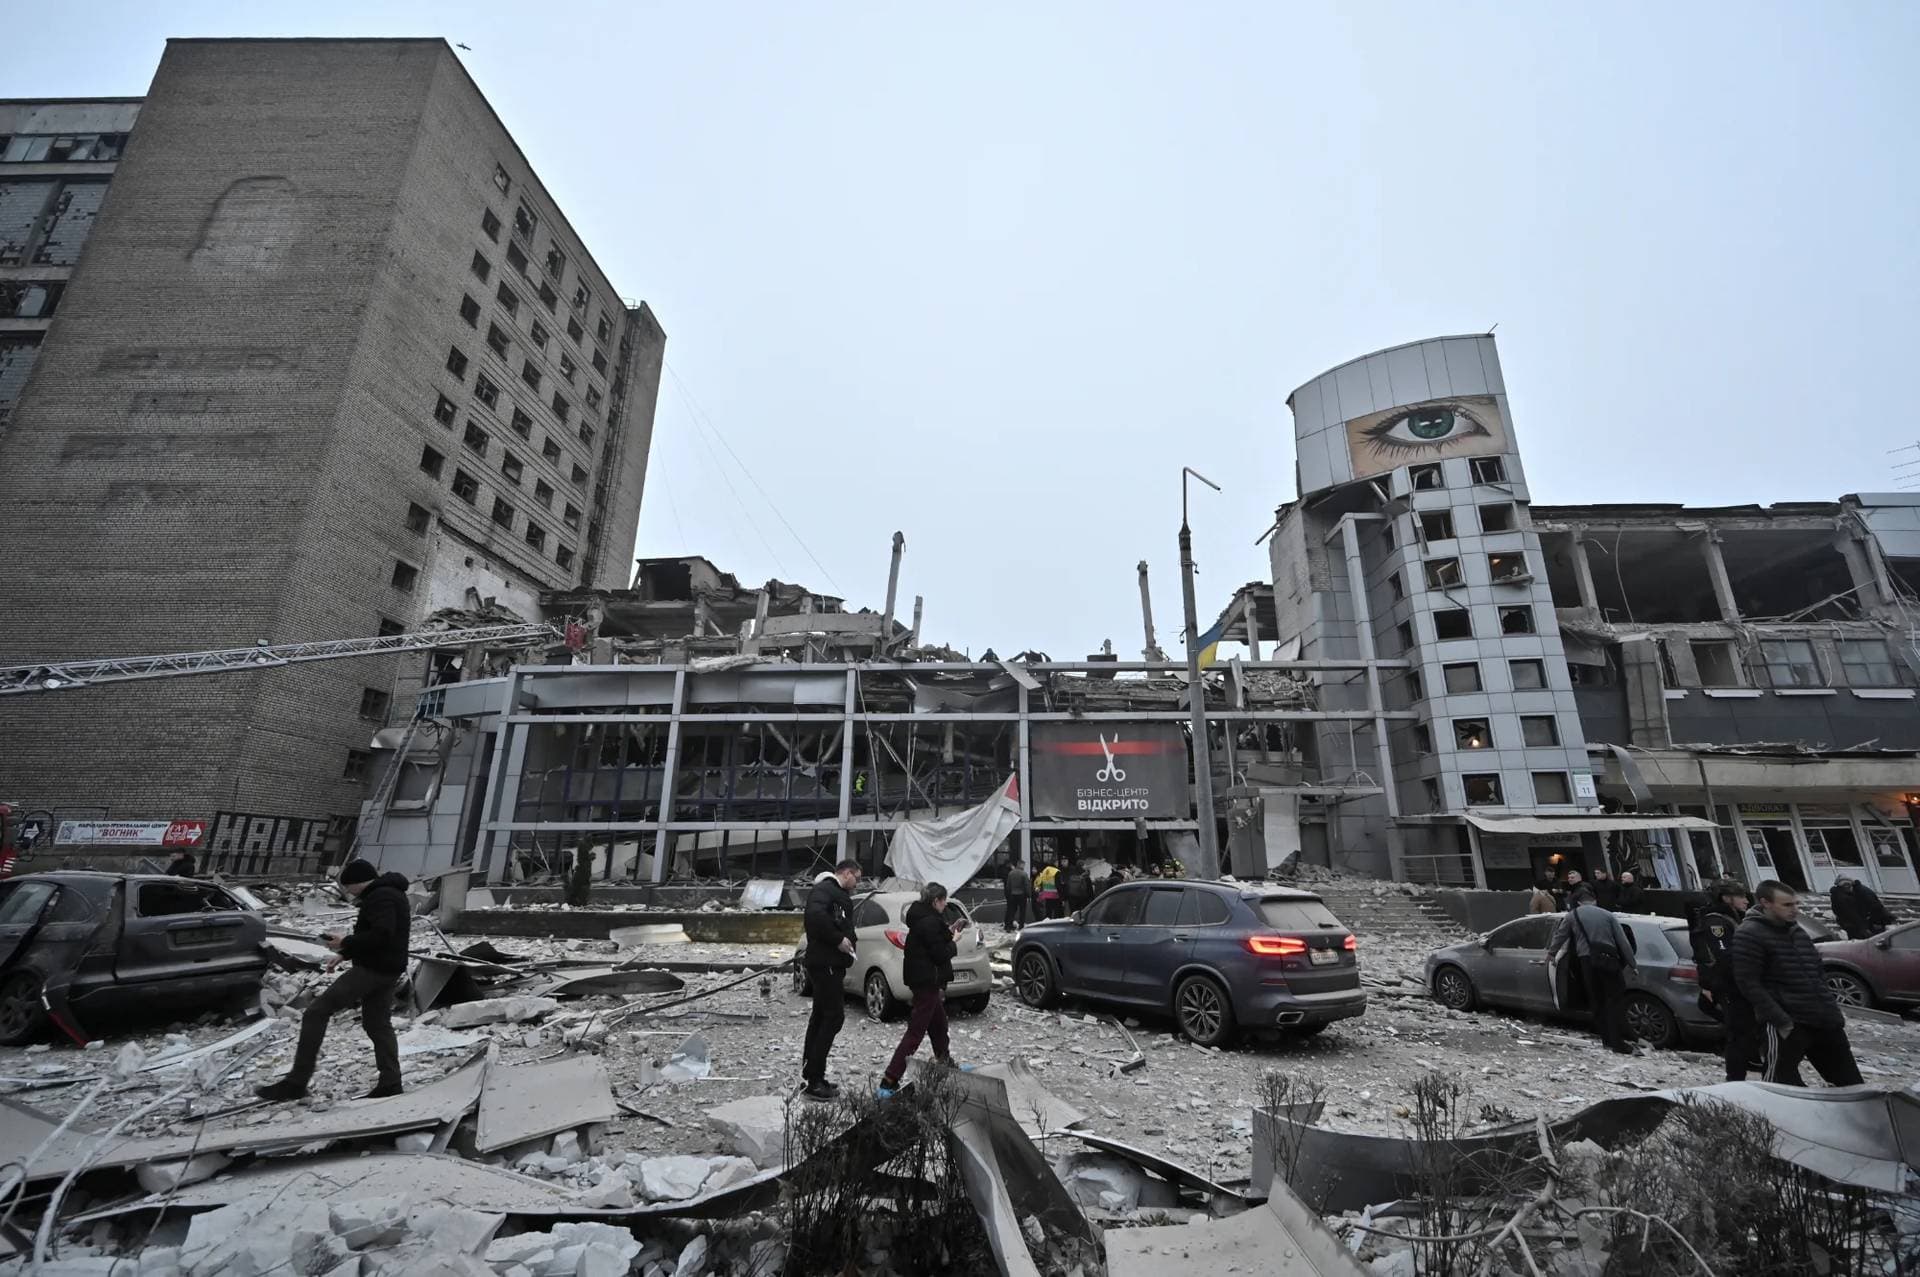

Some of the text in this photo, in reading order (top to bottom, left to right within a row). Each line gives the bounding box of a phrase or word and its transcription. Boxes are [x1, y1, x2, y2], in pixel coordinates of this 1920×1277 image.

[1077, 788, 1149, 798] БІЗНЕС-ЦЕНТР
[1581, 786, 1591, 795] 11
[1078, 799, 1149, 812] ВІДКРИТО
[99, 828, 144, 837] "ВОГНИК"
